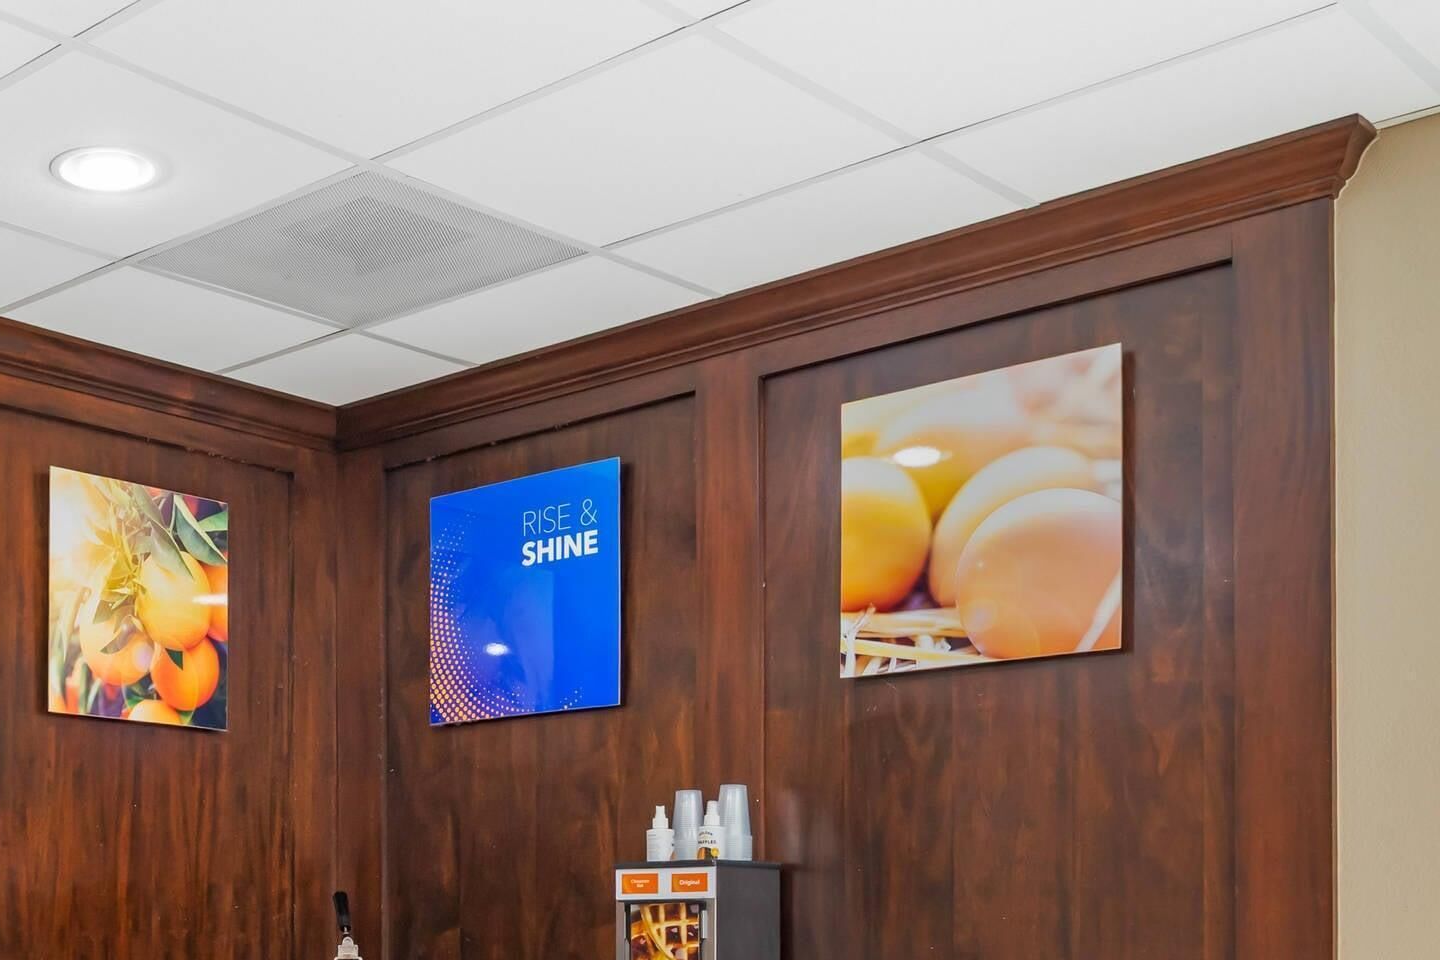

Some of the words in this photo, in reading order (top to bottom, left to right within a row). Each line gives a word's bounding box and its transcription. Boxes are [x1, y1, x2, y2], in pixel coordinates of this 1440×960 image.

[523, 503, 571, 537] RISE
[580, 498, 598, 526] &
[521, 529, 599, 567] SHINE
[679, 879, 701, 887] Original
